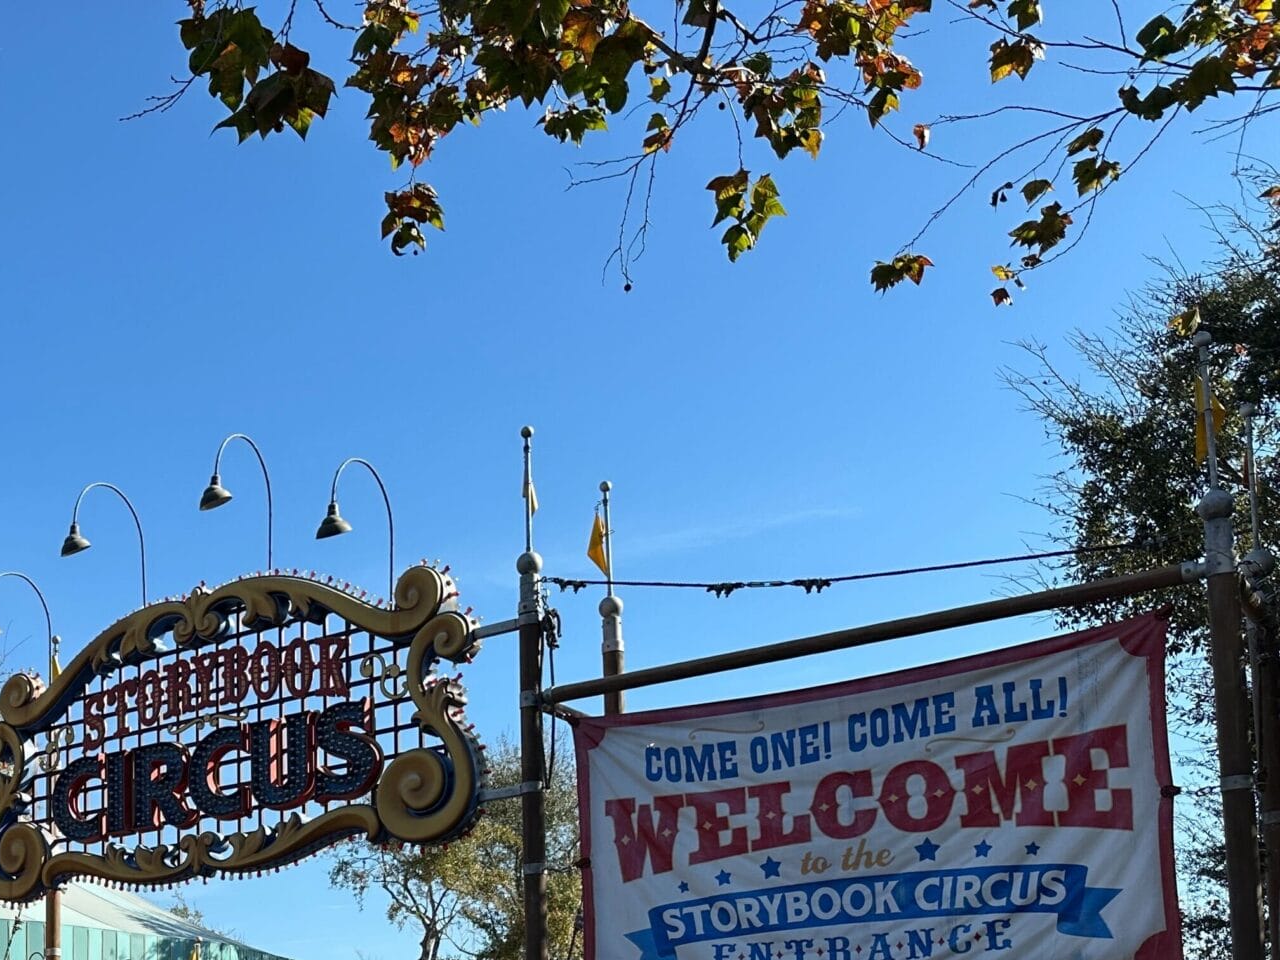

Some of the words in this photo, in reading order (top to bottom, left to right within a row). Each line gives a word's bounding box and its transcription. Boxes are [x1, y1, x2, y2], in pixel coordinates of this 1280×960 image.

[83, 636, 351, 752] STORYBOOK
[645, 740, 739, 784] COME
[750, 721, 832, 774] ONE!
[848, 692, 956, 753] COME
[973, 676, 1069, 728] ALL!
[53, 697, 384, 844] CIRCUS
[605, 723, 1134, 884] WELCOME
[662, 879, 904, 941] STORYBOOK
[914, 869, 1067, 916] CIRCUS
[801, 850, 832, 875] to
[841, 838, 896, 871] the
